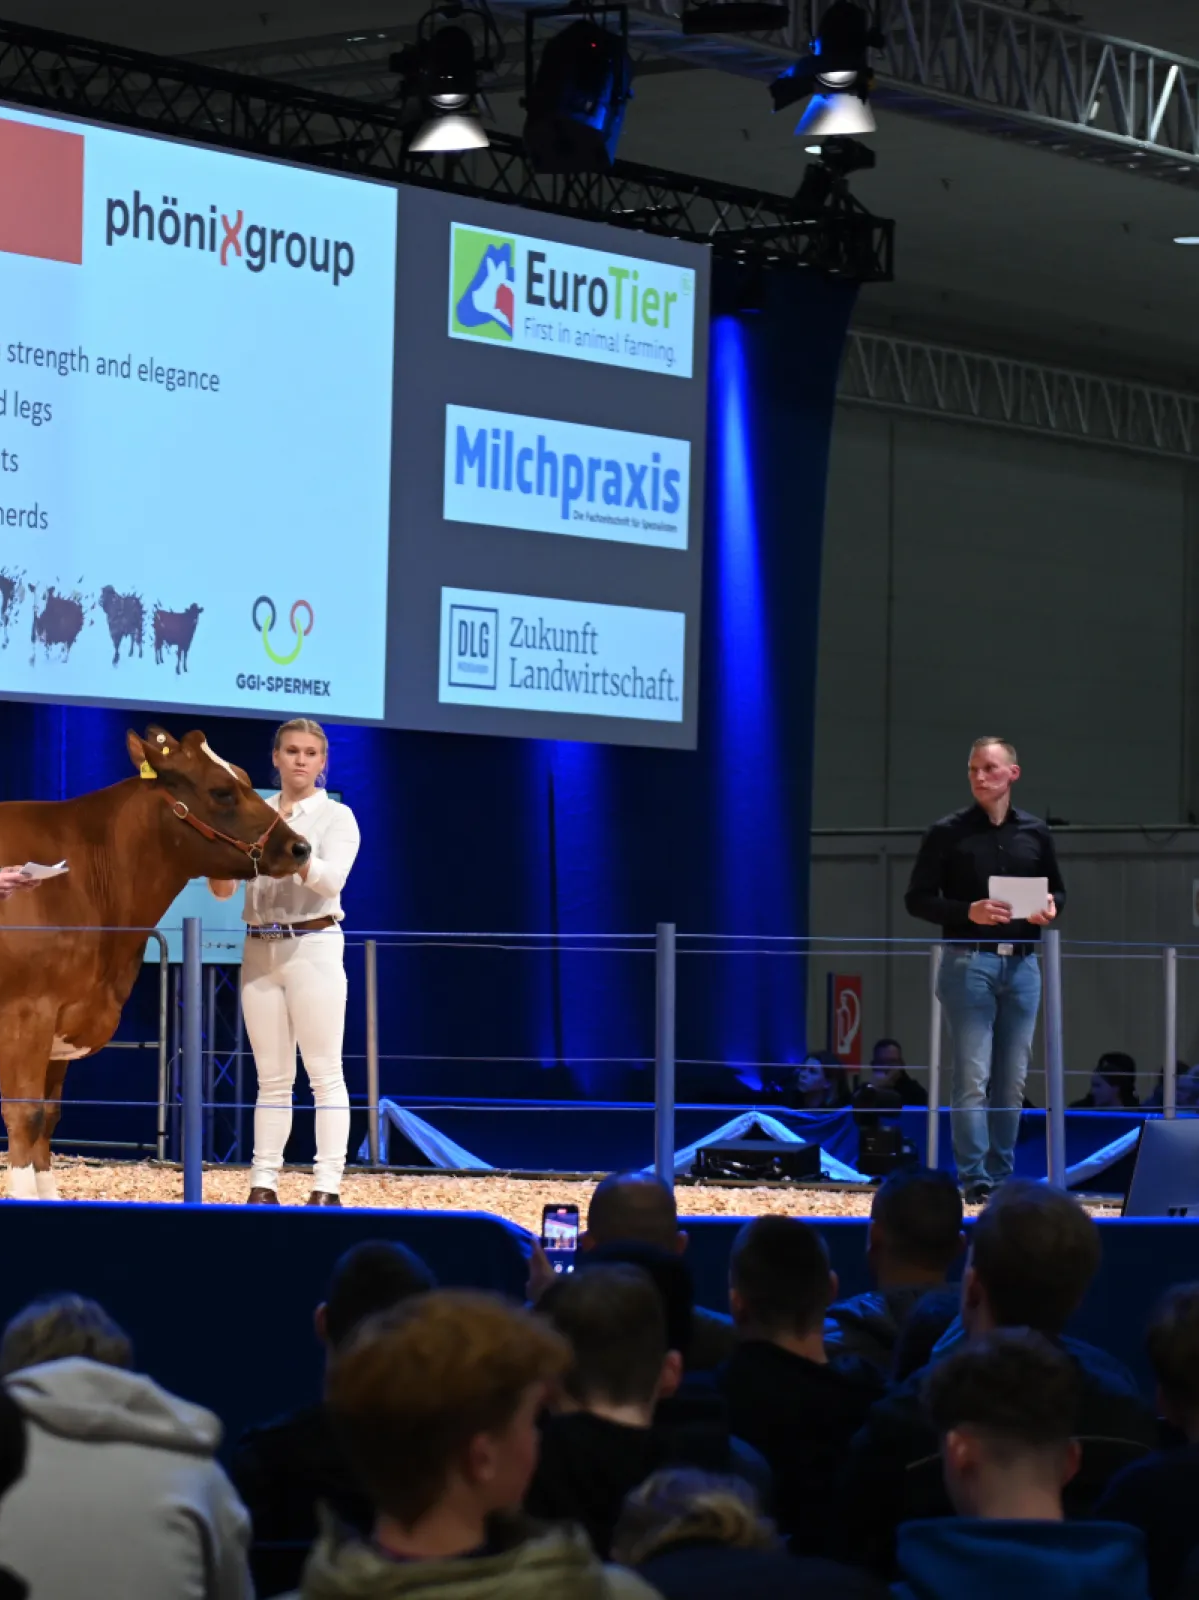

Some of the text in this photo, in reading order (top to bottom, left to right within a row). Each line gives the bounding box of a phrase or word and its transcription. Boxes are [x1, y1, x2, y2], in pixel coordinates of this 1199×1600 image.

[525, 249, 678, 329] EuroTier
[524, 318, 553, 342] First
[558, 322, 570, 344] in
[575, 329, 619, 354] animal
[7, 341, 89, 376] strength
[96, 354, 131, 379] and
[137, 357, 220, 392] elegance
[14, 390, 53, 426] legs
[454, 424, 681, 520] Milchpraxis
[457, 619, 490, 658] DLG
[508, 616, 599, 655] Zukunft
[236, 672, 331, 697] GGI-SPERMEX
[508, 657, 680, 702] Landwirtschaft.
